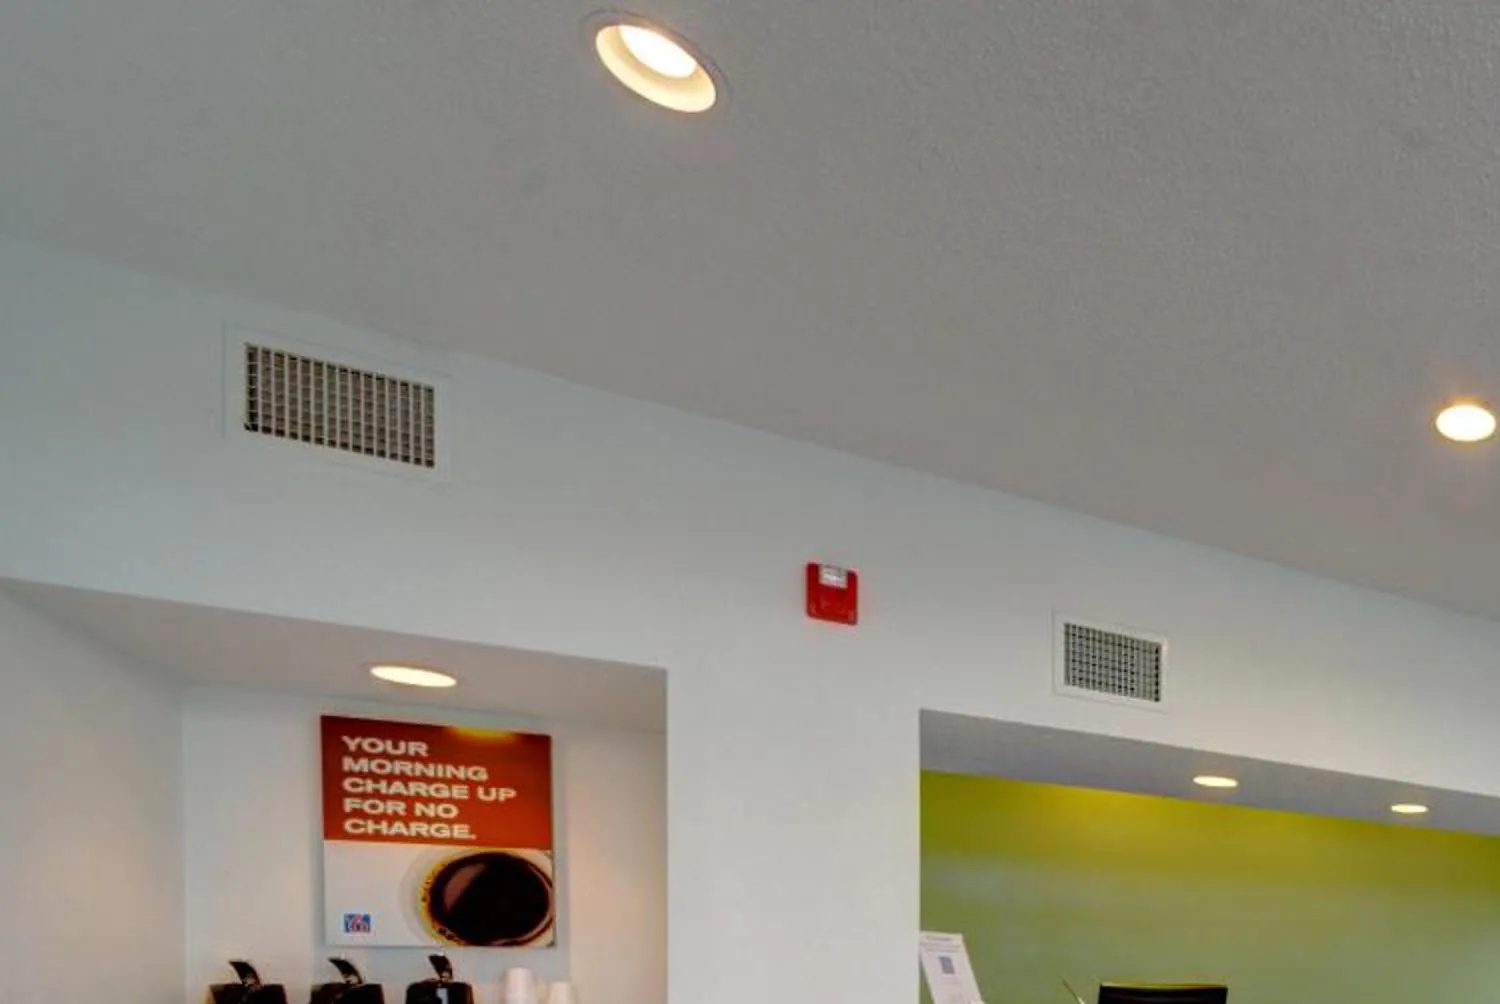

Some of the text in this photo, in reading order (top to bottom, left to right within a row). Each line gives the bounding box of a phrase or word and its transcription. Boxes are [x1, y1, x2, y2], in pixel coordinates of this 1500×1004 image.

[342, 735, 428, 757] YOUR
[342, 756, 488, 781] MORNING
[342, 777, 517, 802] CHARGE UP
[343, 797, 459, 819] FOR NO
[343, 818, 477, 840] CHARGE.
